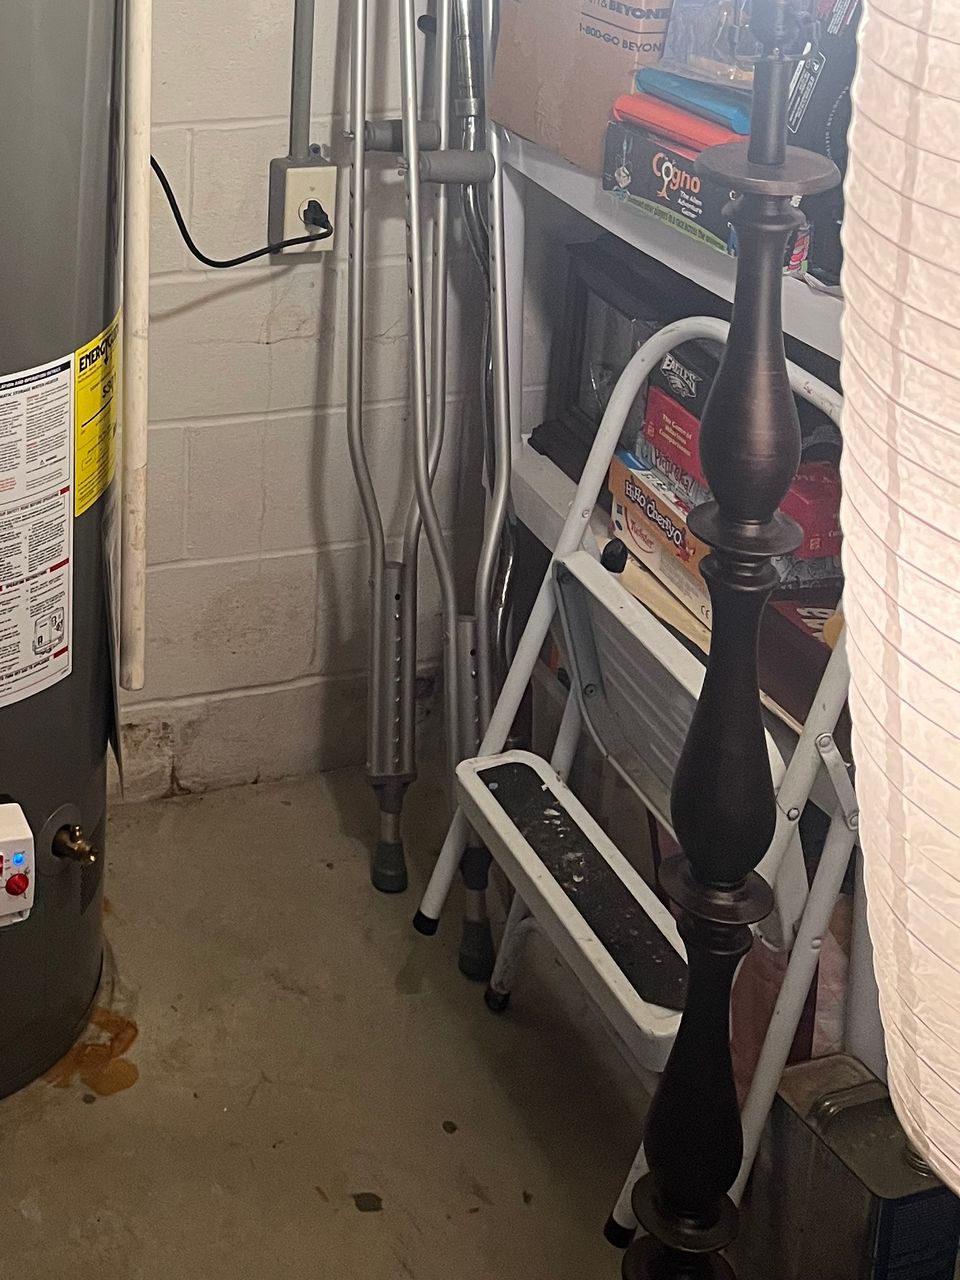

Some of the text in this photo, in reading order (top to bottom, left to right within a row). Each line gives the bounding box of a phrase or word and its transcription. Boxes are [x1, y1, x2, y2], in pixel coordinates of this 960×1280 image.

[578, 22, 664, 53] 1-800-GO BEYON
[652, 152, 701, 198] Cogno
[661, 352, 701, 389] EAGLES
